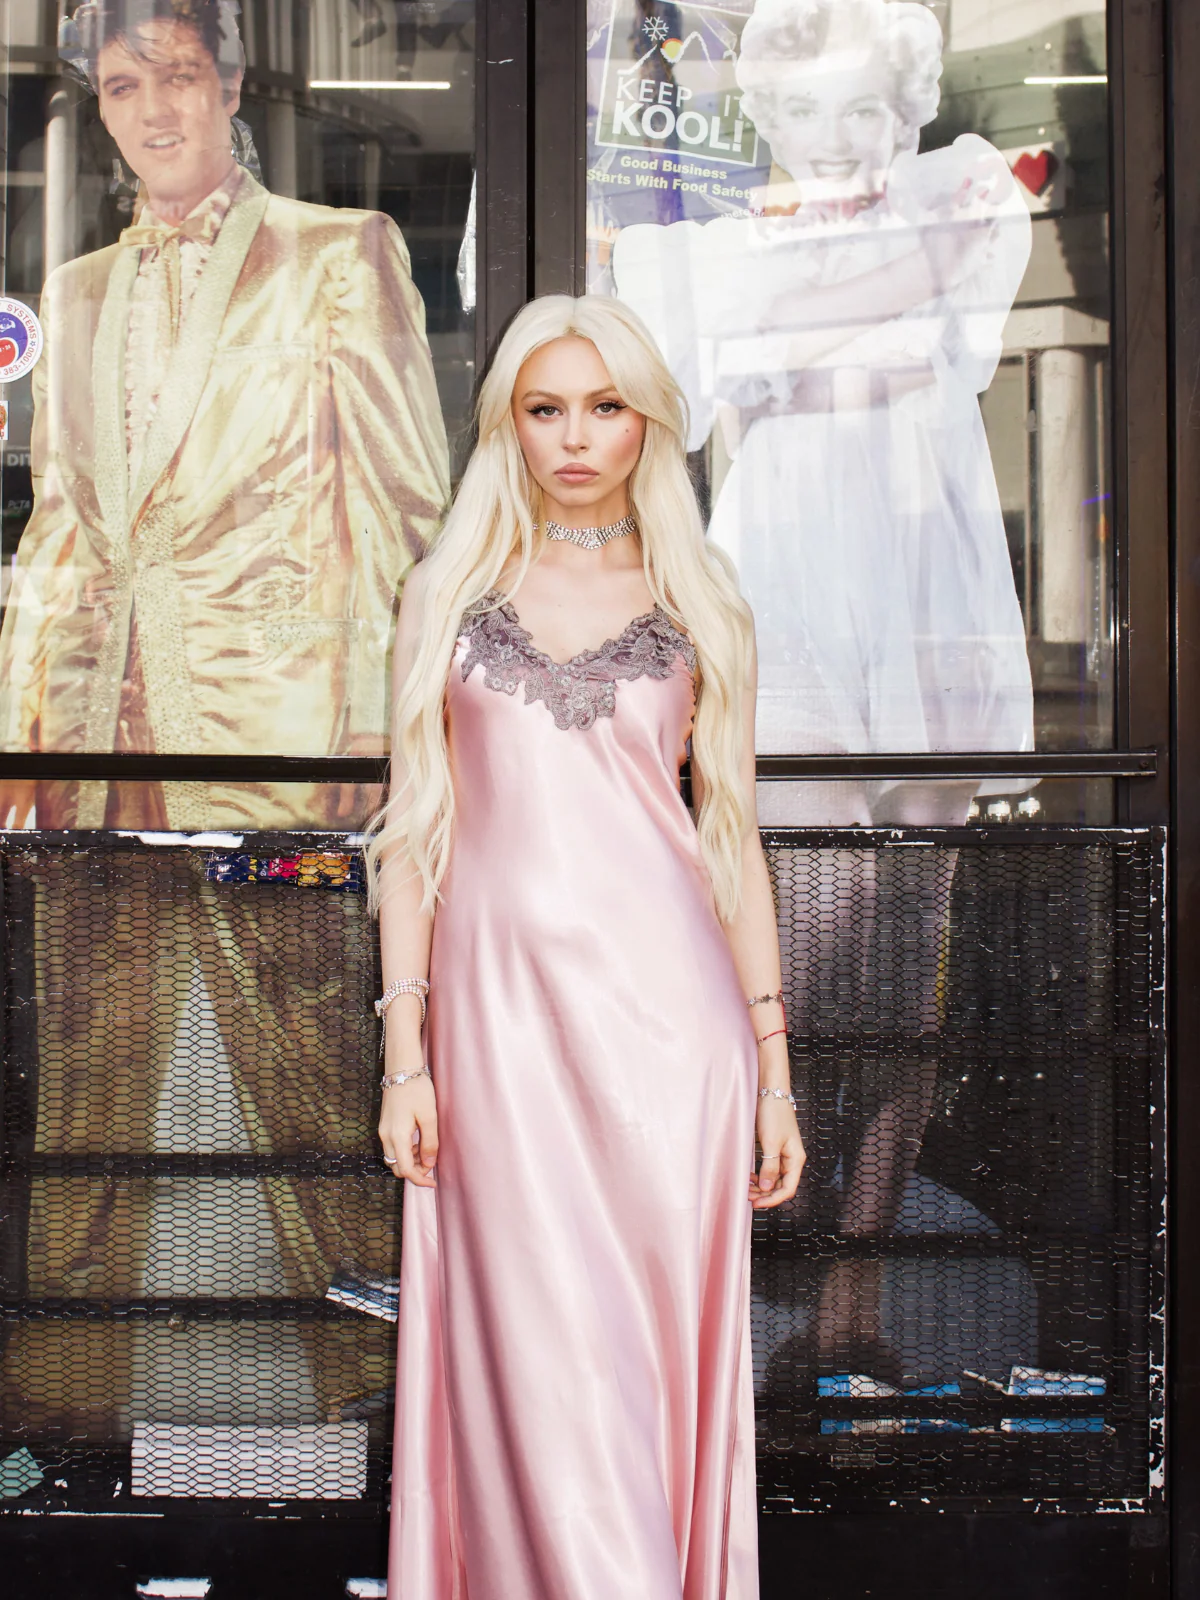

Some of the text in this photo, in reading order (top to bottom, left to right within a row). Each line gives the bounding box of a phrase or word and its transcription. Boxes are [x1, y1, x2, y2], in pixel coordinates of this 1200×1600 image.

[616, 77, 693, 107] KEEP
[611, 100, 745, 153] KOOL!
[620, 155, 728, 180] Good Business
[586, 169, 758, 202] Starts With Food Safety
[6, 304, 37, 339] SYSTEMS
[3, 347, 35, 376] 383-1000
